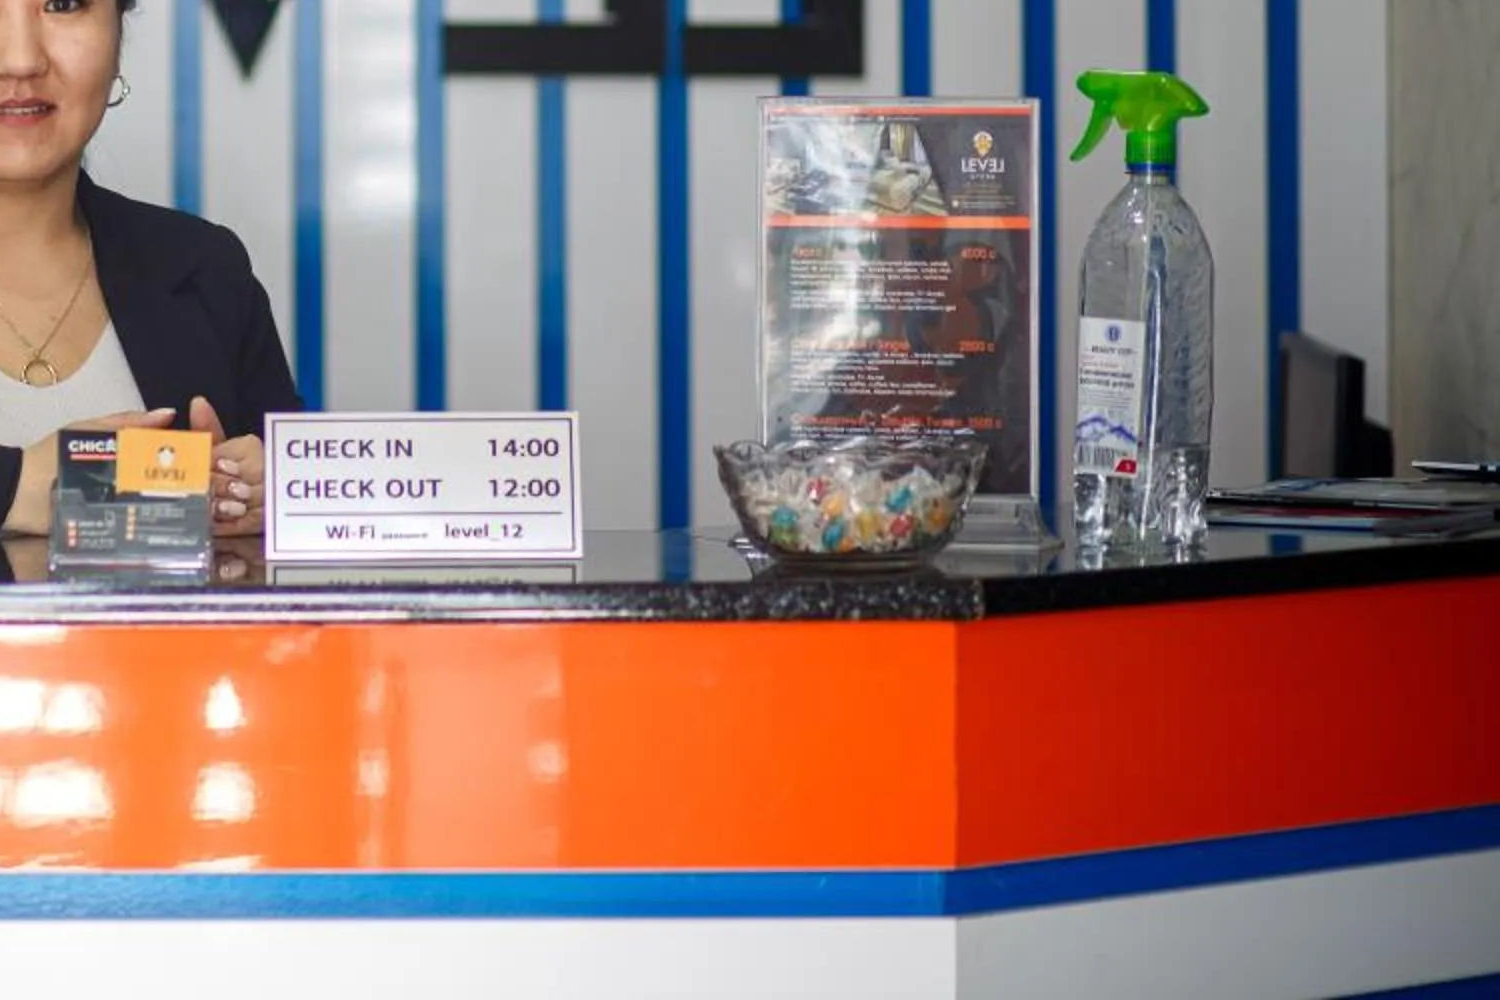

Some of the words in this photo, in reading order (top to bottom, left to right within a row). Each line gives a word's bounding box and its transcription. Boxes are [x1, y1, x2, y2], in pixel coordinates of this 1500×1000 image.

[961, 157, 1005, 173] LEVEL
[286, 439, 375, 458] CHECK
[386, 439, 413, 458] IN
[488, 438, 560, 457] 14:00
[286, 479, 375, 499] CHECK
[386, 479, 442, 499] OUT
[488, 479, 561, 498] 12:00
[326, 525, 375, 539] Wi-Fi
[445, 523, 524, 541] level_12
